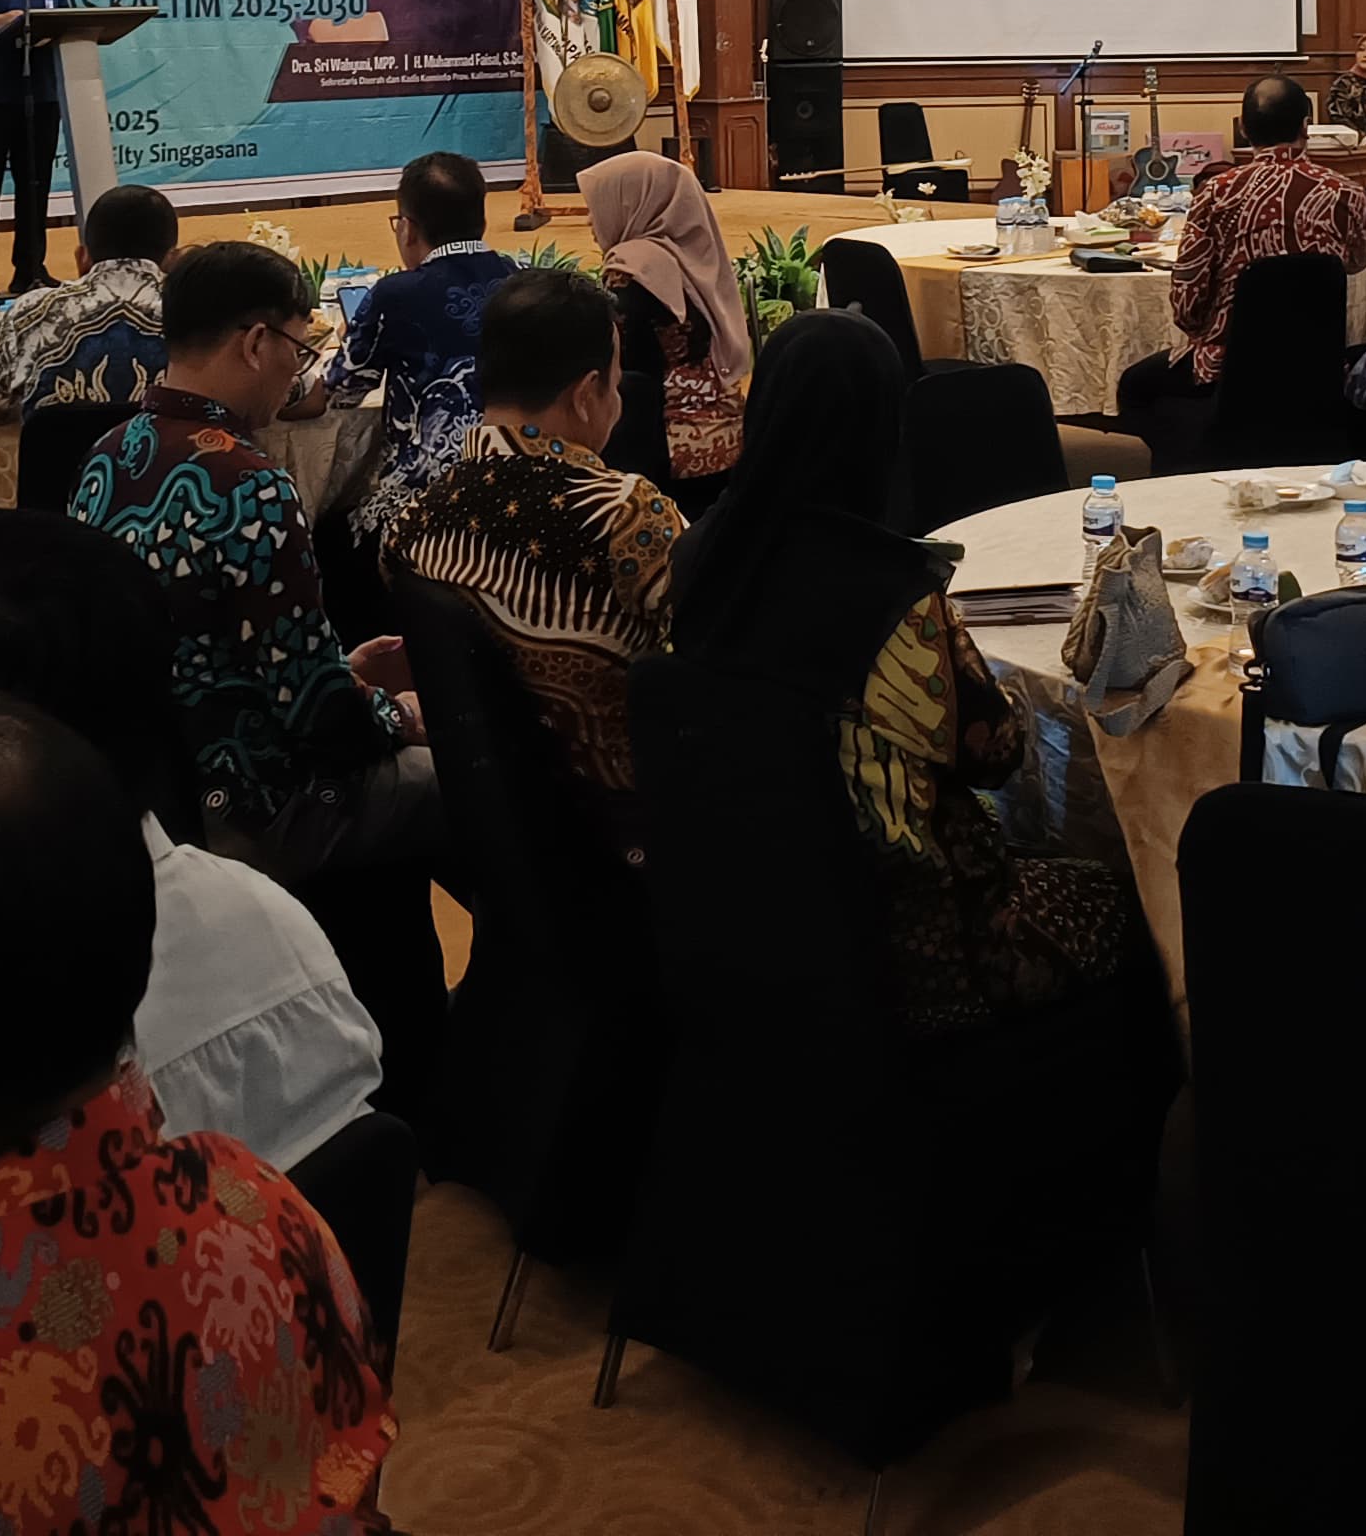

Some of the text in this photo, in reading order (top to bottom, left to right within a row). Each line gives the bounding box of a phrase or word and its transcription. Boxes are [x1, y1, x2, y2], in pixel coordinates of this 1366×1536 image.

[292, 59, 312, 73] Dra.
[315, 58, 329, 72] Sri
[150, 141, 259, 168] Singgasana
